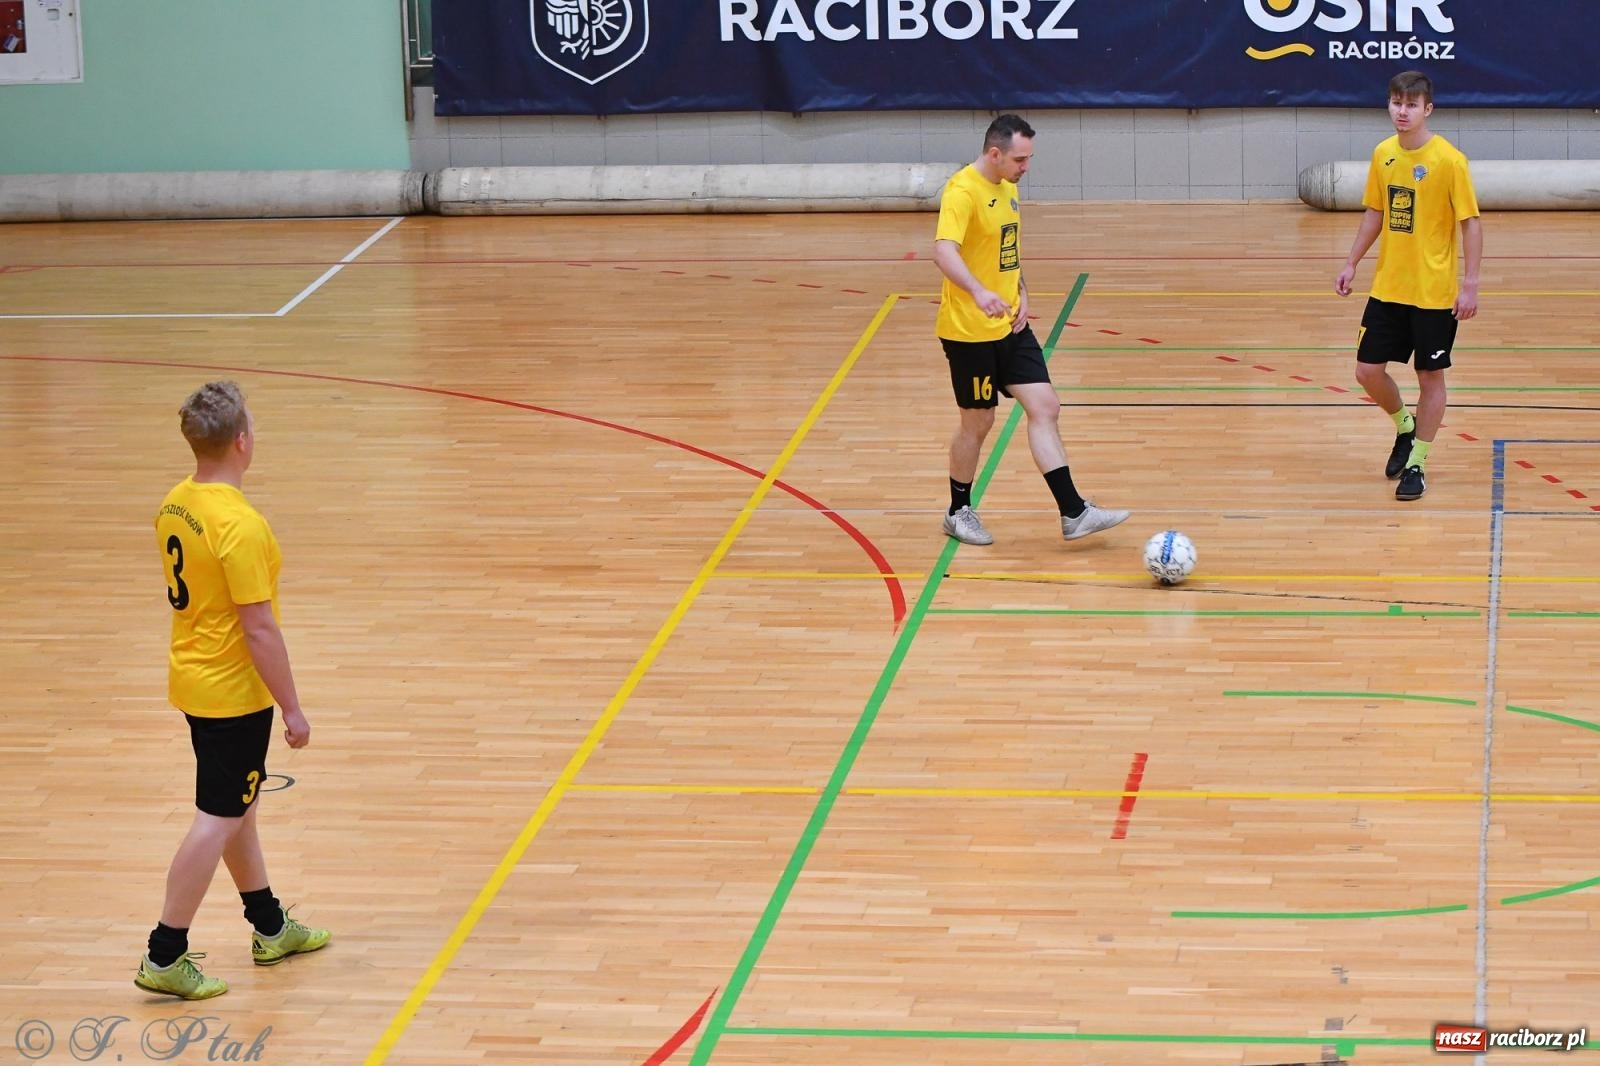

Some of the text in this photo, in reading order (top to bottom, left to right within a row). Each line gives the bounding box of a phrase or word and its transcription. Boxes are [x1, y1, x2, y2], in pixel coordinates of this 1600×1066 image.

[1329, 36, 1455, 60] RACIBÓRZ
[973, 376, 993, 401] 16
[166, 534, 189, 611] 3
[242, 770, 260, 804] 3
